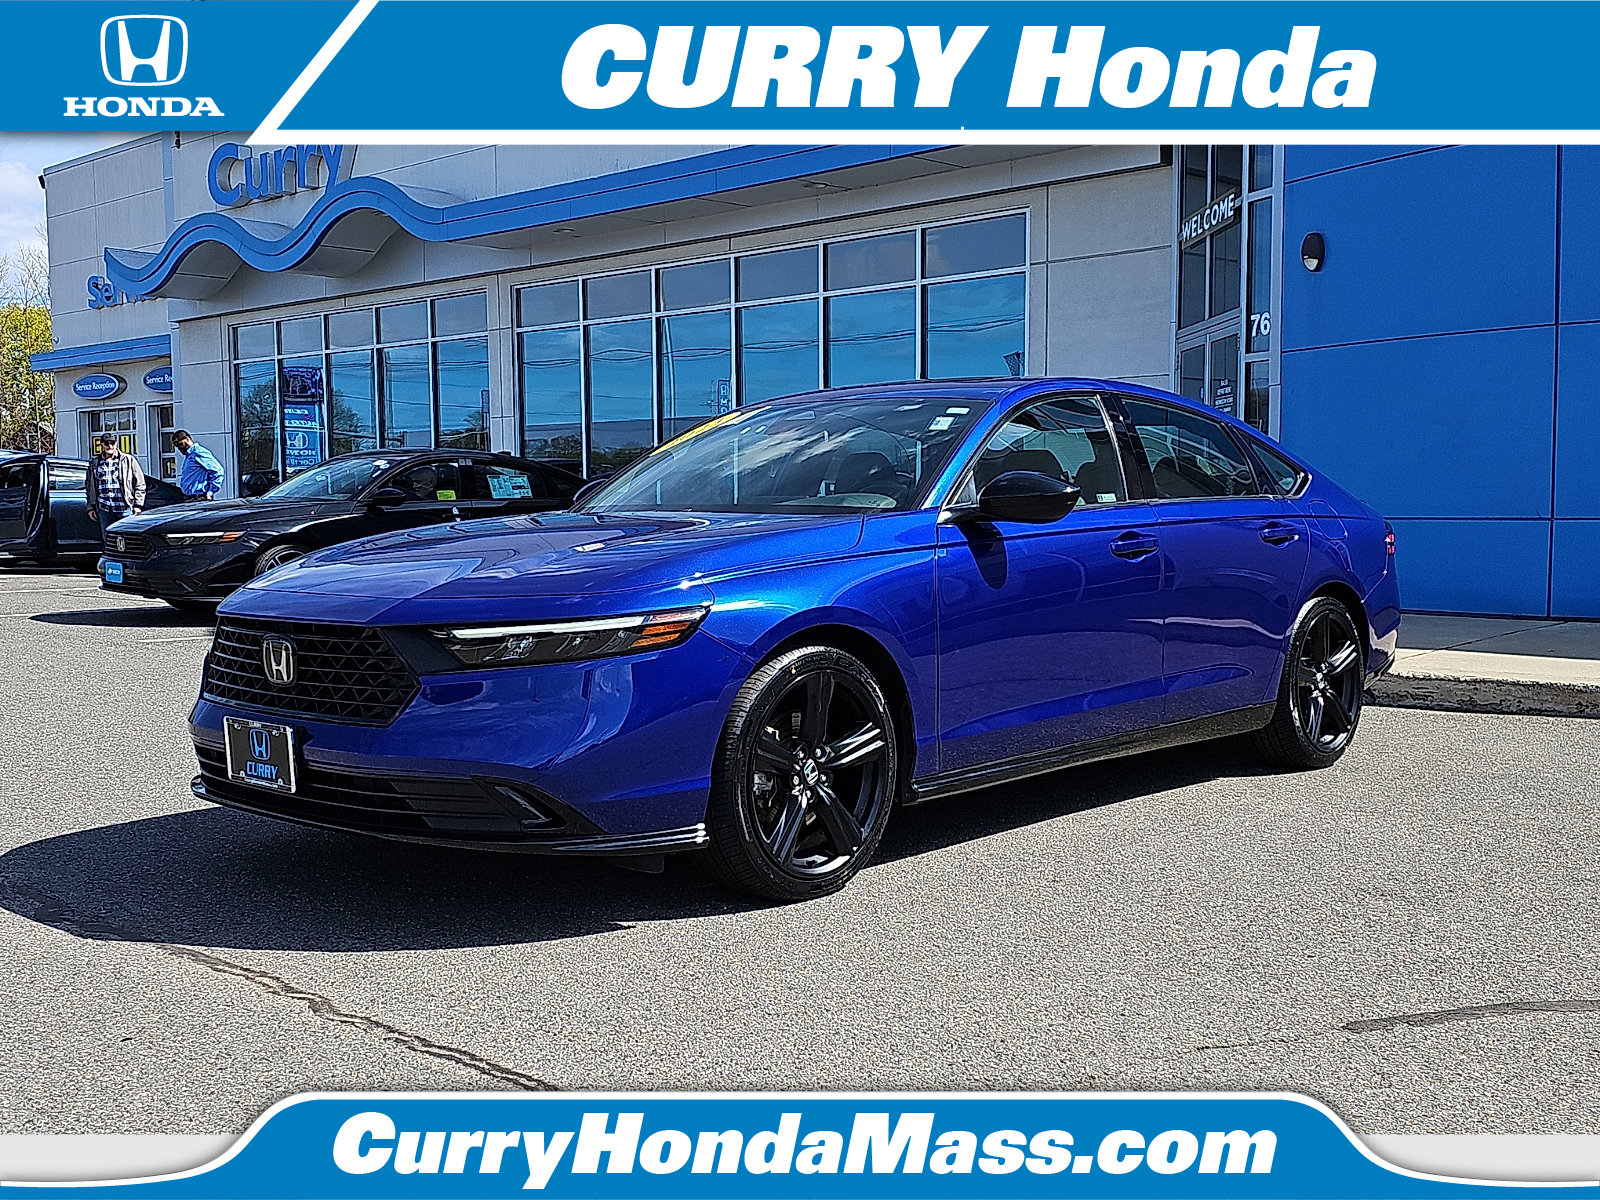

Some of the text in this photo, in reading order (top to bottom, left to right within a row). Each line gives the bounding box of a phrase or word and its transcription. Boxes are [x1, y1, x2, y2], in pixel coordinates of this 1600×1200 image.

[207, 142, 345, 207] Curry
[1181, 193, 1236, 243] WELCOME
[1250, 311, 1271, 337] 76
[75, 380, 115, 391] Service Reception
[146, 374, 164, 385] Service
[246, 761, 279, 780] CURRY
